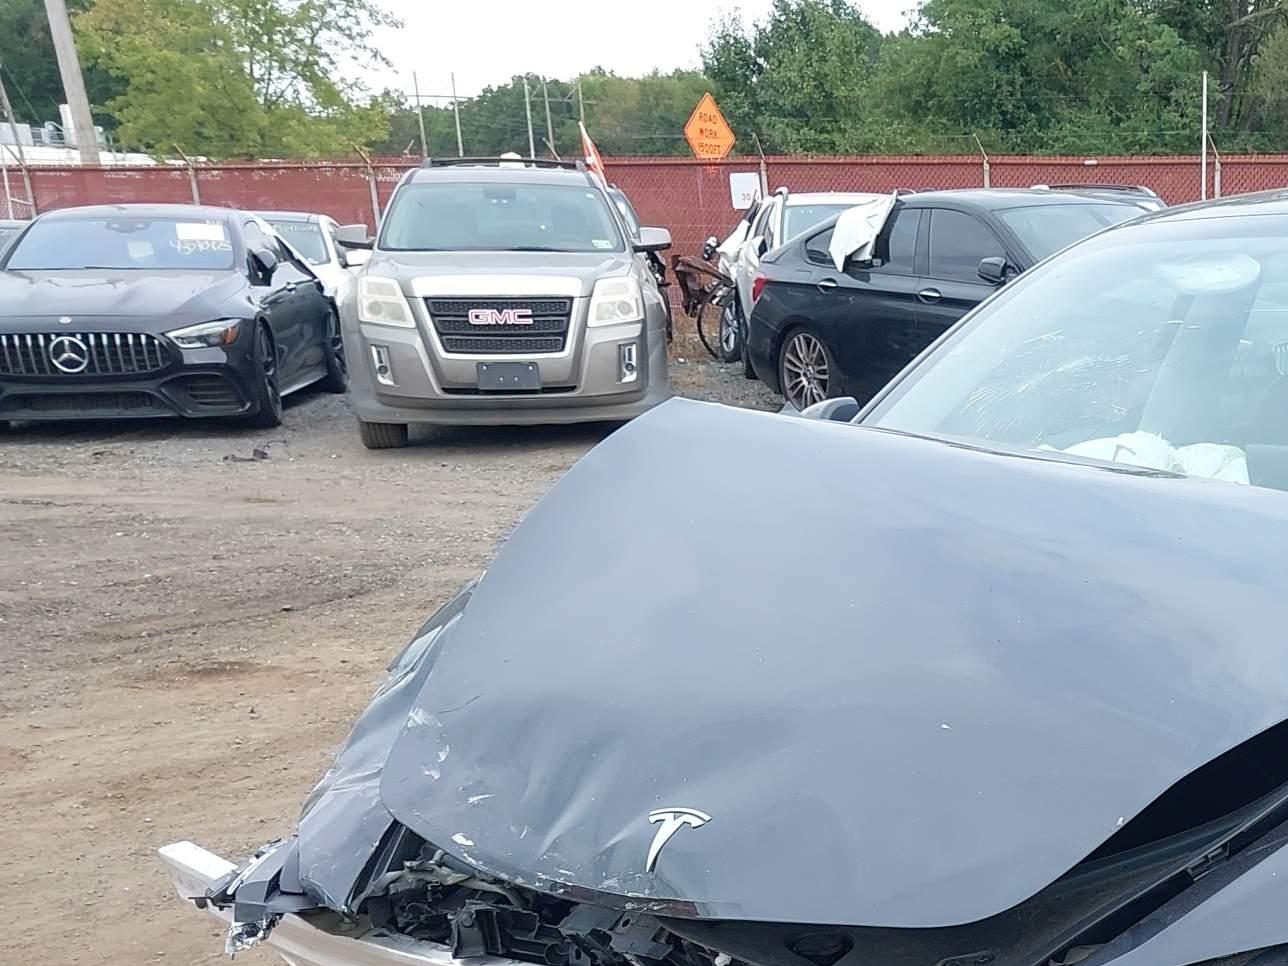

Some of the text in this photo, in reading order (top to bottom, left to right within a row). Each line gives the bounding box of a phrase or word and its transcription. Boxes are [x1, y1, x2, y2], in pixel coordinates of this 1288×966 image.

[699, 112, 717, 125] ROAD
[699, 127, 718, 139] WORK
[468, 308, 534, 325] GMC
